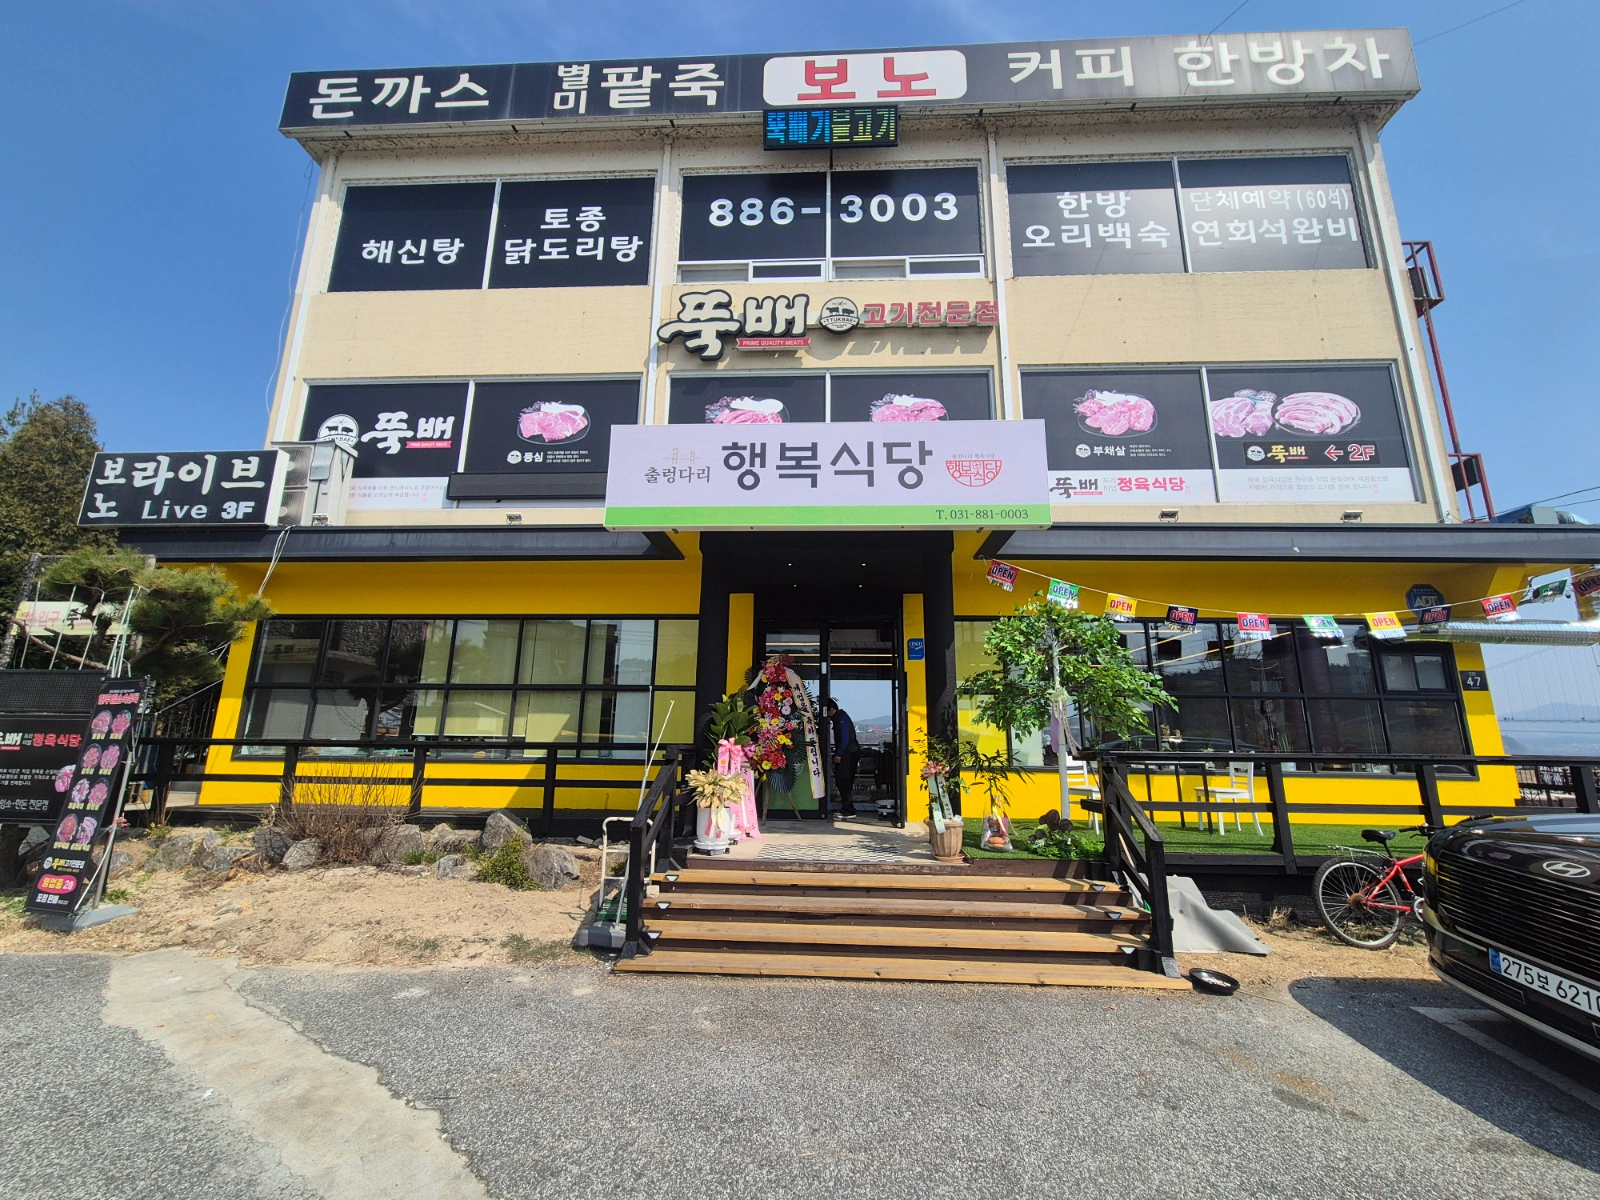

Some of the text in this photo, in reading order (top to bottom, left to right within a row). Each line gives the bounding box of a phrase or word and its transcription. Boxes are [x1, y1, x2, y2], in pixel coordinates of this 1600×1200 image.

[1007, 36, 1390, 89] 커피 한방차
[797, 56, 937, 101] 보노
[309, 73, 490, 120] 돈까스
[1056, 190, 1131, 219] 한방
[540, 206, 606, 232] 토종
[1022, 219, 1170, 249] 오리백숙
[1191, 217, 1358, 246] 연회석완비
[361, 237, 465, 265] 해신탕
[504, 235, 643, 265] 닭도리탕
[863, 300, 999, 326] 고기전문점
[657, 289, 811, 361] 뚝배
[361, 411, 455, 455] 뚝배
[523, 451, 544, 463] 등심
[1093, 445, 1126, 457] 부채살
[1267, 445, 1306, 463] 뚝배
[1347, 444, 1376, 461] 2F
[644, 465, 711, 484] 출렁다리
[721, 440, 934, 490] 행복식당
[1049, 477, 1098, 499] 뚝배
[1117, 477, 1185, 492] 정육식당
[141, 500, 256, 520] Live 3F
[991, 565, 1015, 580] OPEN
[1052, 584, 1075, 597] OPEN
[1109, 599, 1133, 612] OPEN
[1413, 595, 1437, 608] ADT
[1487, 600, 1511, 612] OPEN
[1169, 609, 1195, 622] OPEN
[1242, 618, 1266, 628] OPEN
[1371, 617, 1397, 627] OPEN
[1422, 609, 1448, 622] OPEN
[1466, 676, 1481, 687] 47
[32, 733, 82, 748] 정육식당
[1502, 957, 1551, 992] 275보
